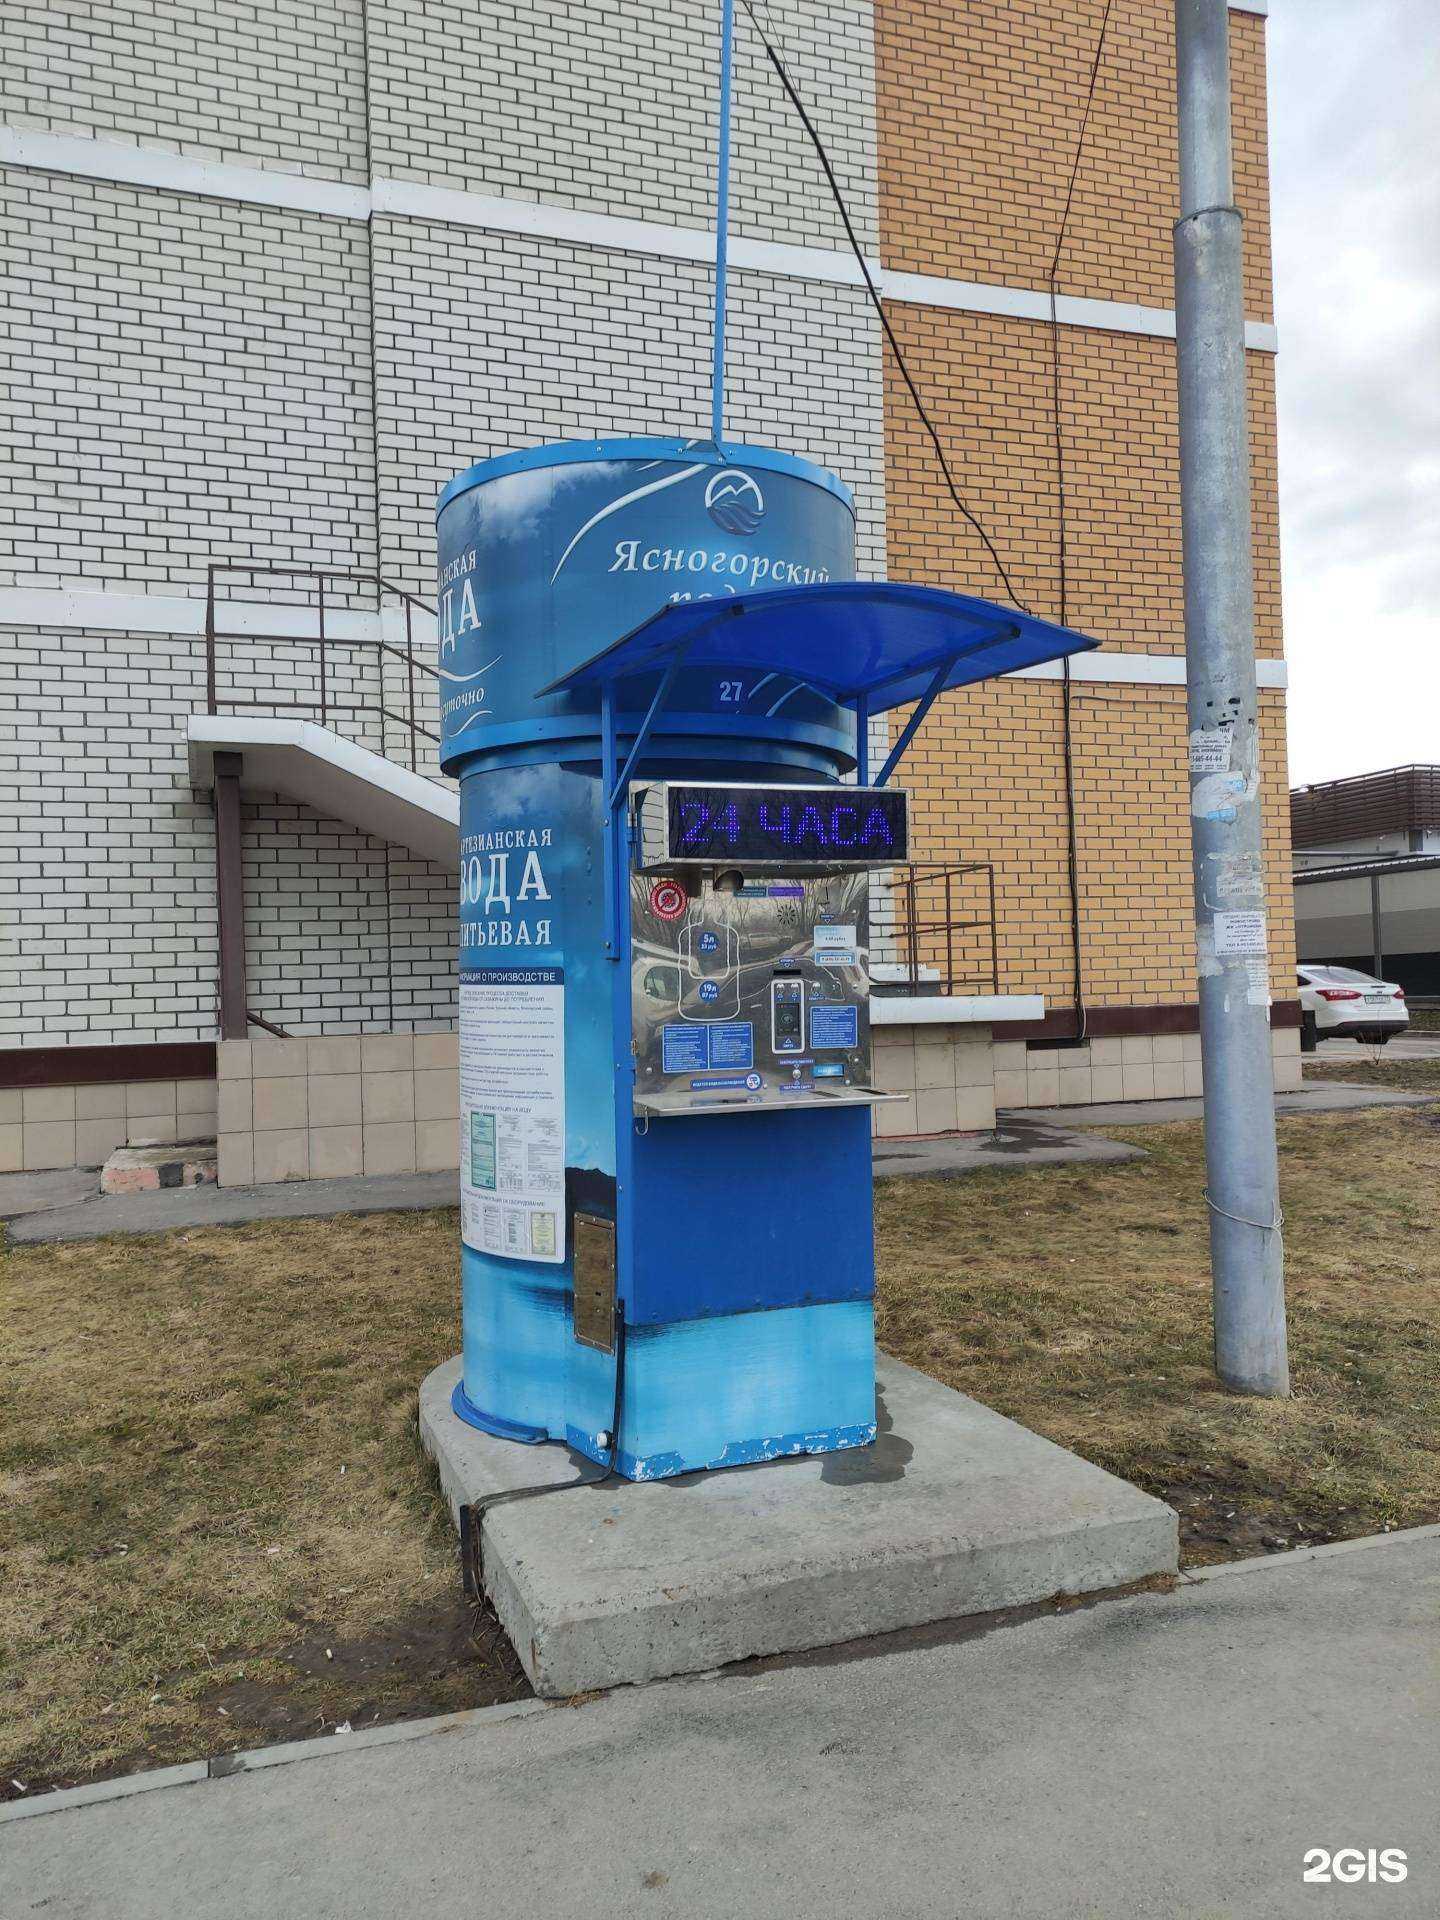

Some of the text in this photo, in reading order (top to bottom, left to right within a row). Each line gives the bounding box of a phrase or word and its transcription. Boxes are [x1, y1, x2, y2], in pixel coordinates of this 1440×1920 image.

[608, 540, 830, 586] Ясногорский
[440, 577, 482, 659] ДА
[719, 681, 744, 702] 27
[680, 802, 894, 846] 24 ЧАСА
[481, 972, 488, 982] О
[488, 972, 556, 983] ПРОИЗВОДСТВЕ
